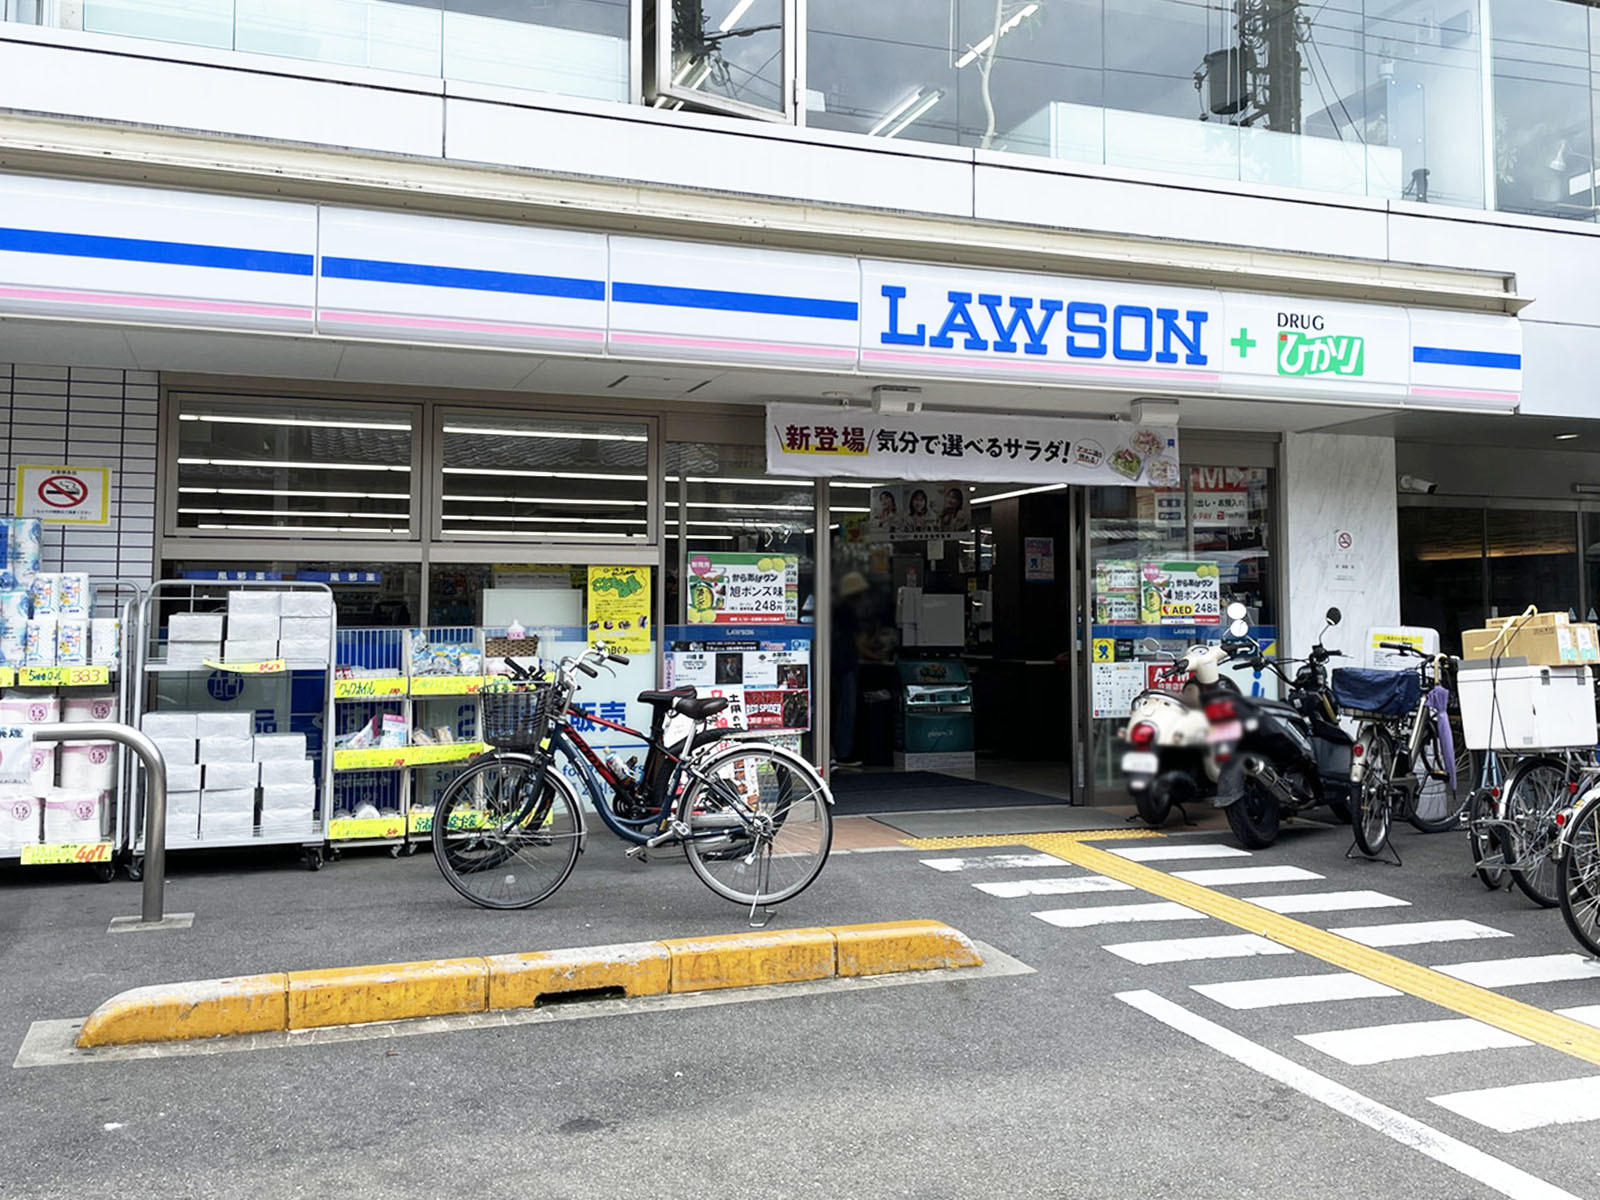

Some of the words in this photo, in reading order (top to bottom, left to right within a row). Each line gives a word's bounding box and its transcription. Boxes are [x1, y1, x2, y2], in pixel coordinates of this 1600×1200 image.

[881, 285, 1208, 365] LAWSON
[1277, 312, 1325, 331] DRUG
[1278, 332, 1364, 376] ひかり
[786, 425, 866, 453] 新登場
[876, 428, 1071, 464] 気分で選べるサラダ!
[1172, 606, 1192, 614] AED
[72, 670, 101, 683] 333
